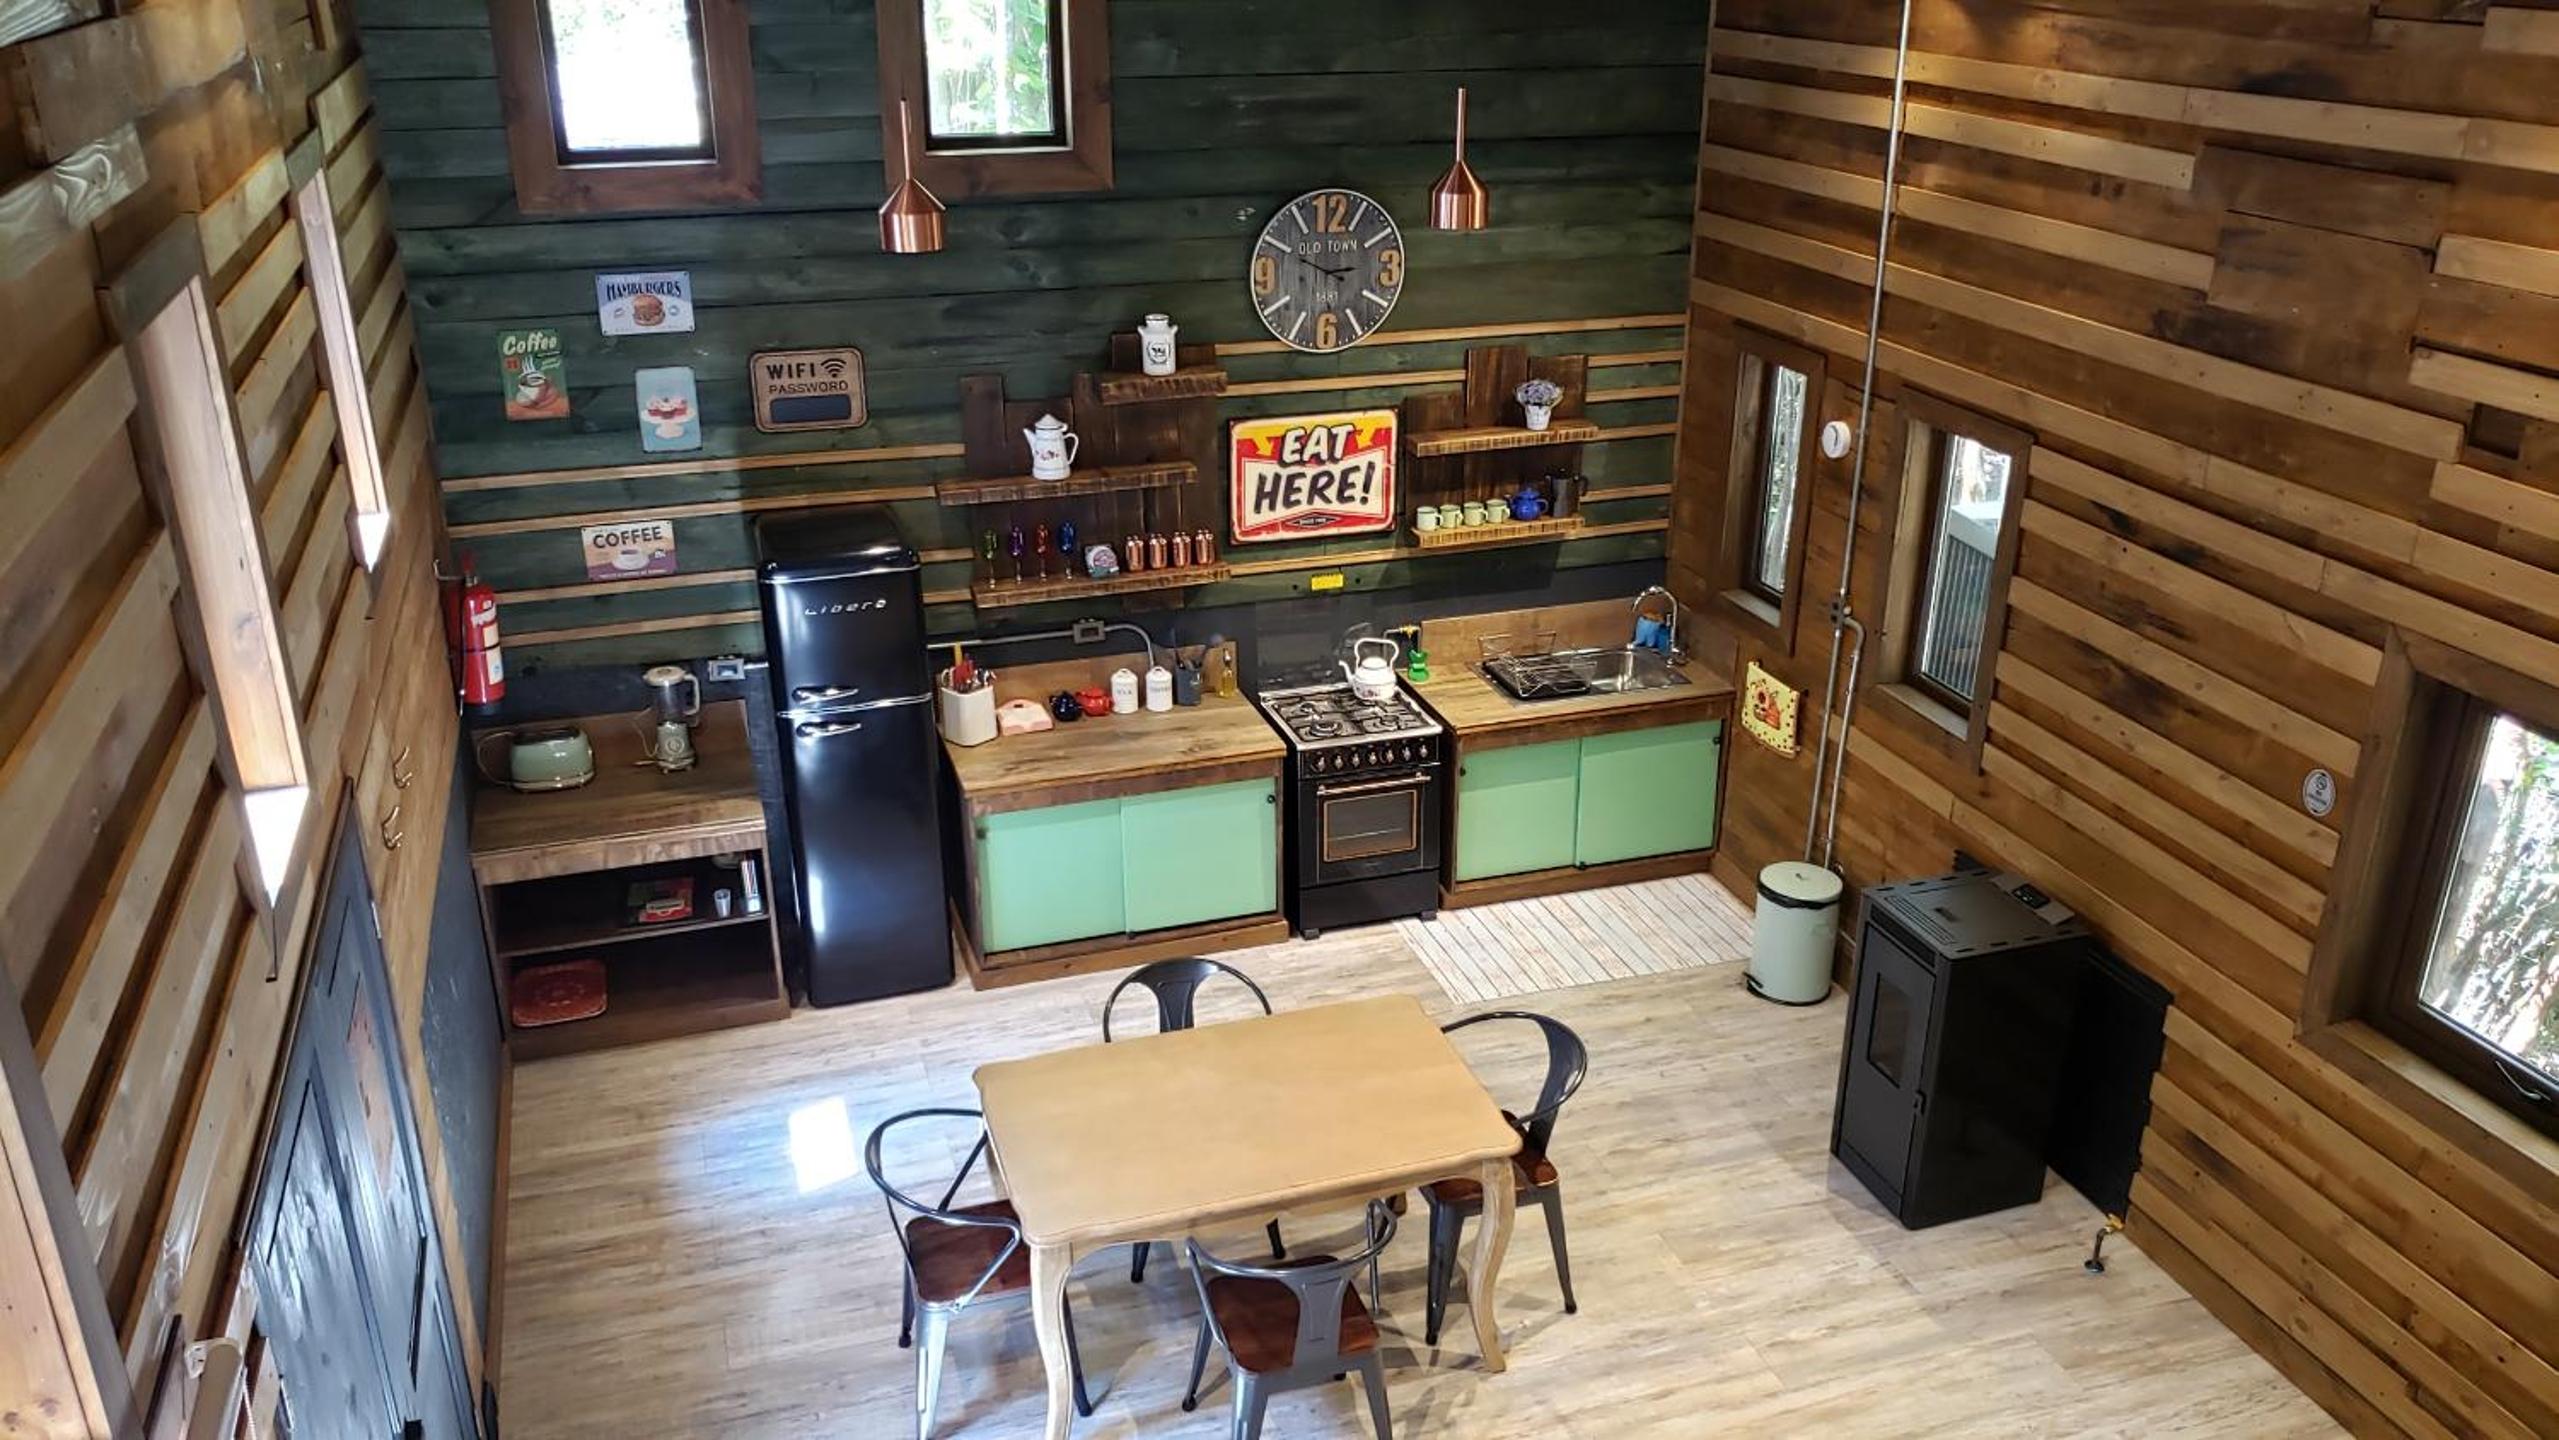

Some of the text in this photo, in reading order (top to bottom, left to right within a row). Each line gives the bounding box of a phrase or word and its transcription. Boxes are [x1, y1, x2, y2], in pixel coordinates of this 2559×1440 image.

[1312, 194, 1348, 233] 12
[1298, 239, 1357, 255] OLD TOWN
[1255, 256, 1276, 295] 9
[1378, 250, 1401, 287] 3
[606, 280, 682, 301] HAMBURGERS
[1316, 312, 1338, 349] 6
[503, 331, 558, 356] Coffee
[766, 362, 817, 379] WIFI
[768, 380, 849, 395] PASSWORD
[1280, 425, 1356, 468] EAT
[1254, 461, 1376, 514] HERE!
[593, 525, 663, 548] COFFEE
[804, 599, 888, 616] Libero
